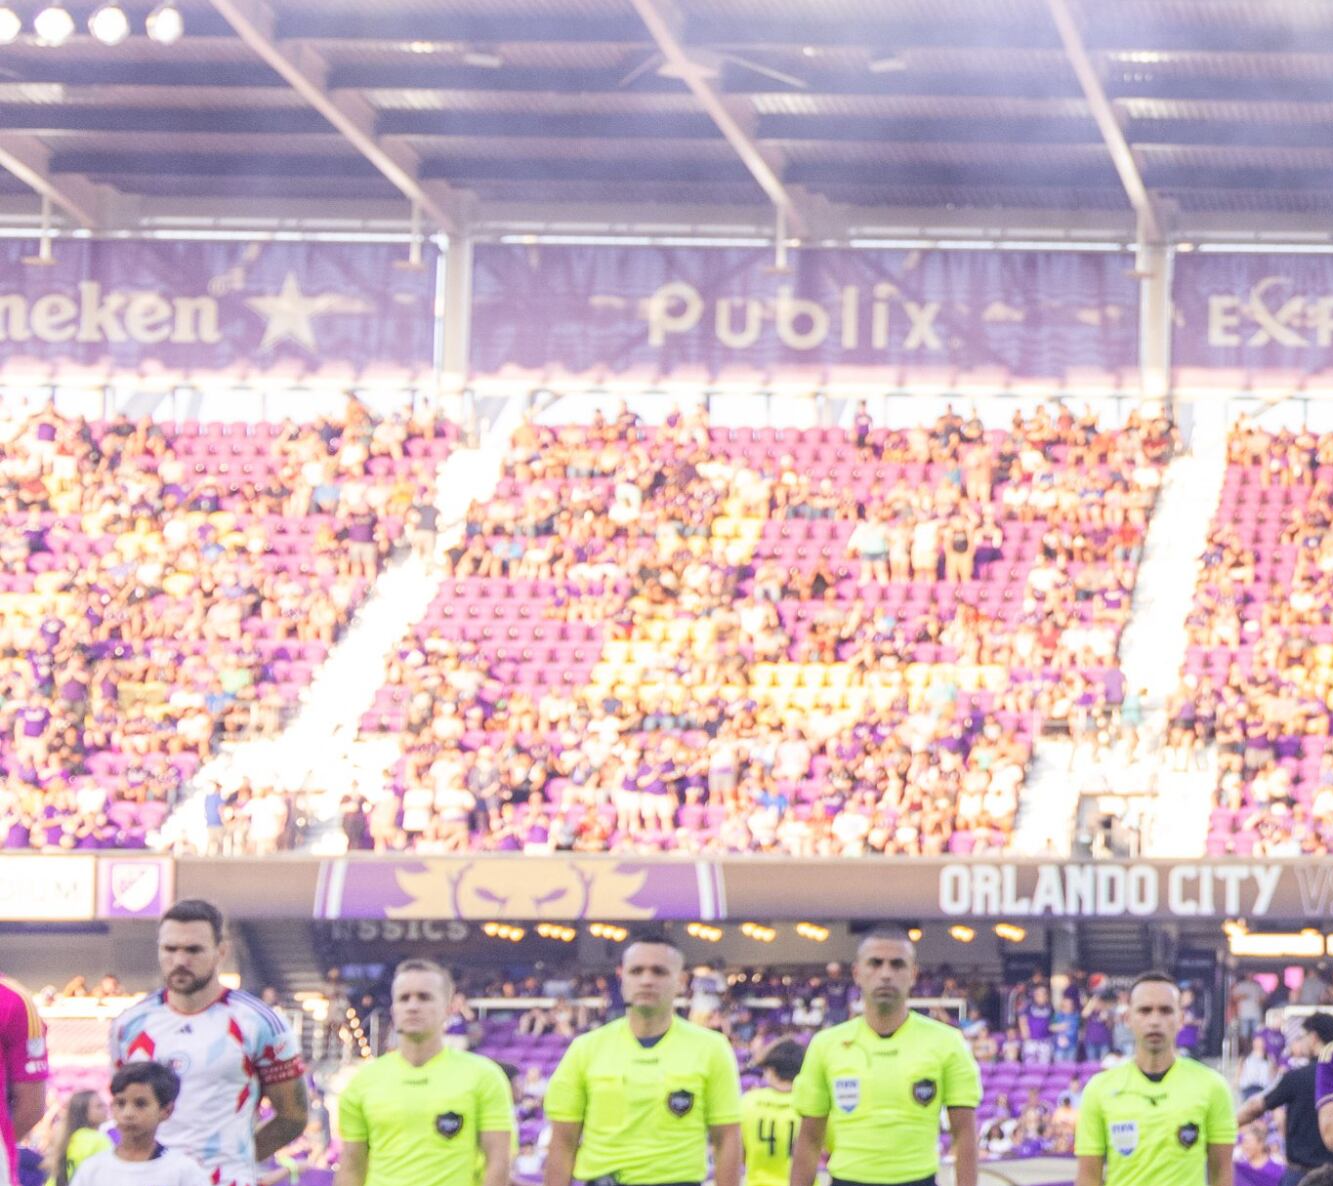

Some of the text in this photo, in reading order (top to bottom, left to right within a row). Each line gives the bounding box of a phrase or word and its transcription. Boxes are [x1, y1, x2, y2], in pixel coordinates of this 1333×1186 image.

[647, 281, 944, 351] Publix
[939, 864, 1156, 916] ORLANDO
[1168, 864, 1284, 916] CITY
